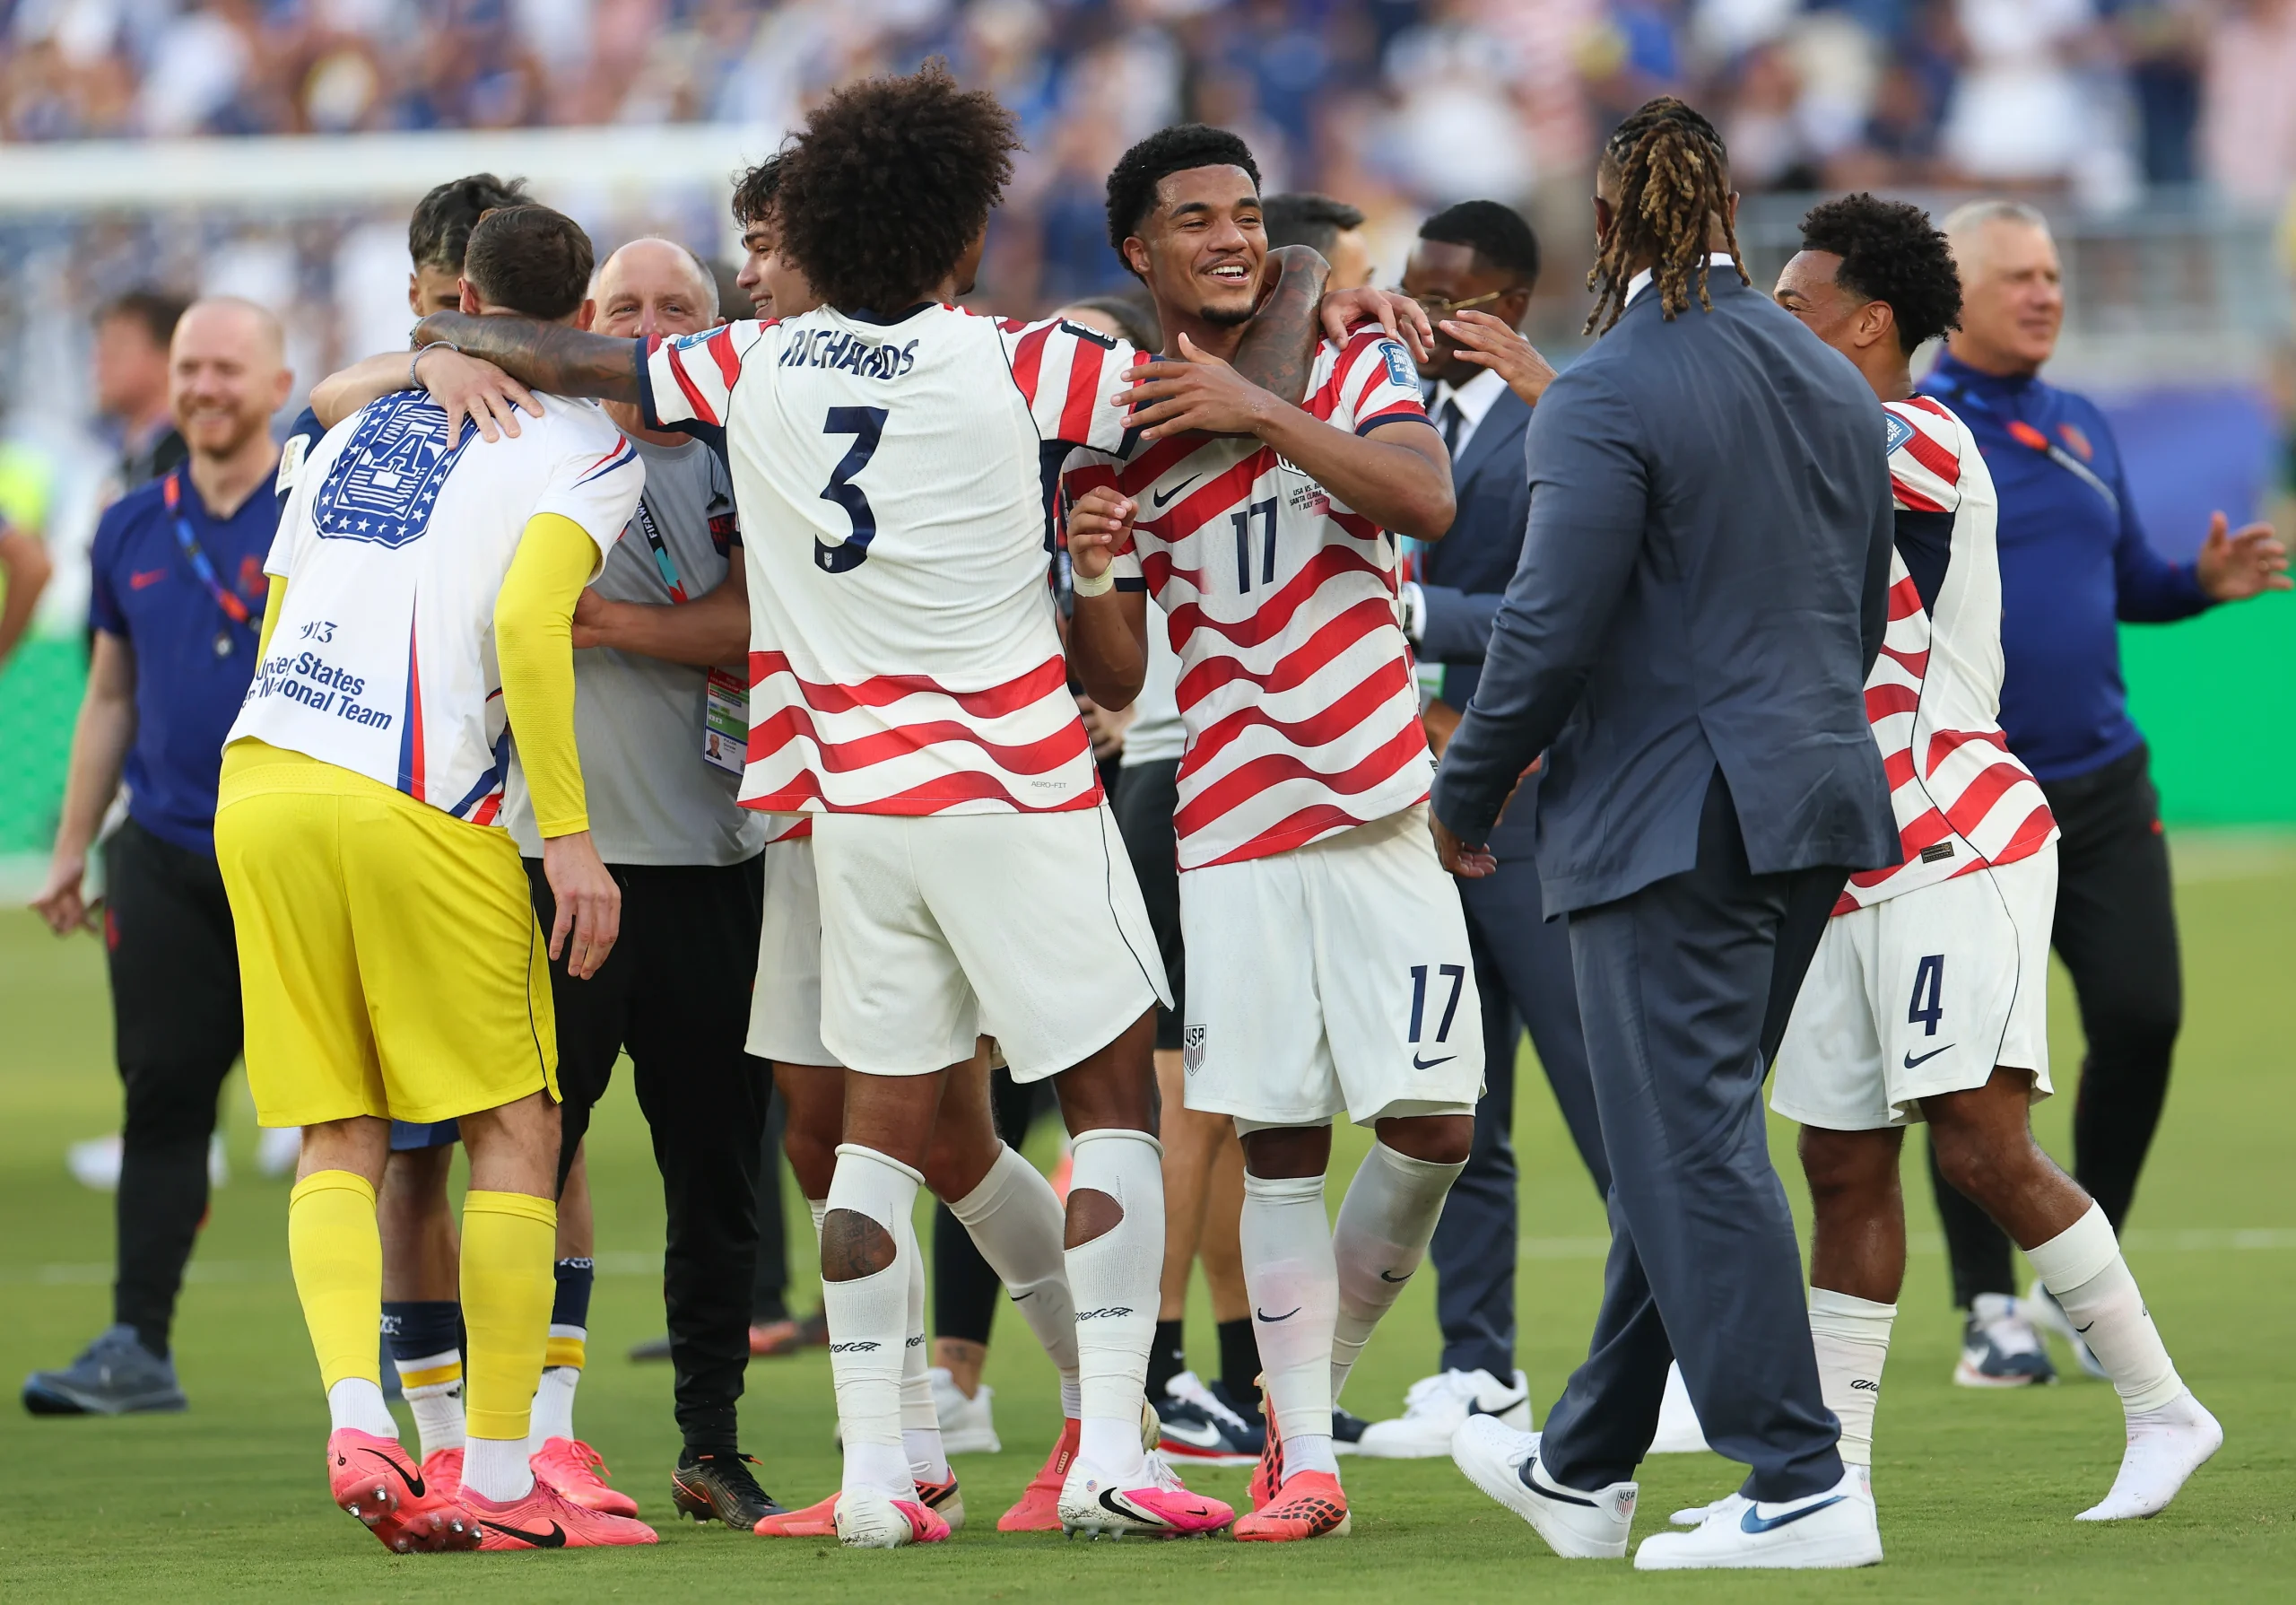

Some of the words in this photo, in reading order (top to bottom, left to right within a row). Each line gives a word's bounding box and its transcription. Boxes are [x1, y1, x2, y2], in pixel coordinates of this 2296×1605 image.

[779, 328, 919, 380] RICHARDS
[814, 406, 890, 574] 3
[1289, 494, 1306, 507] SANTA
[1302, 500, 1314, 510] JULY
[642, 516, 658, 539] FIFA
[1231, 496, 1278, 595] 17
[295, 651, 366, 696] States
[337, 695, 393, 730] Team
[1031, 781, 1066, 789] AERO-FIT
[1408, 964, 1465, 1042] 17
[1908, 954, 1944, 1036] 4
[1186, 1027, 1205, 1047] USA
